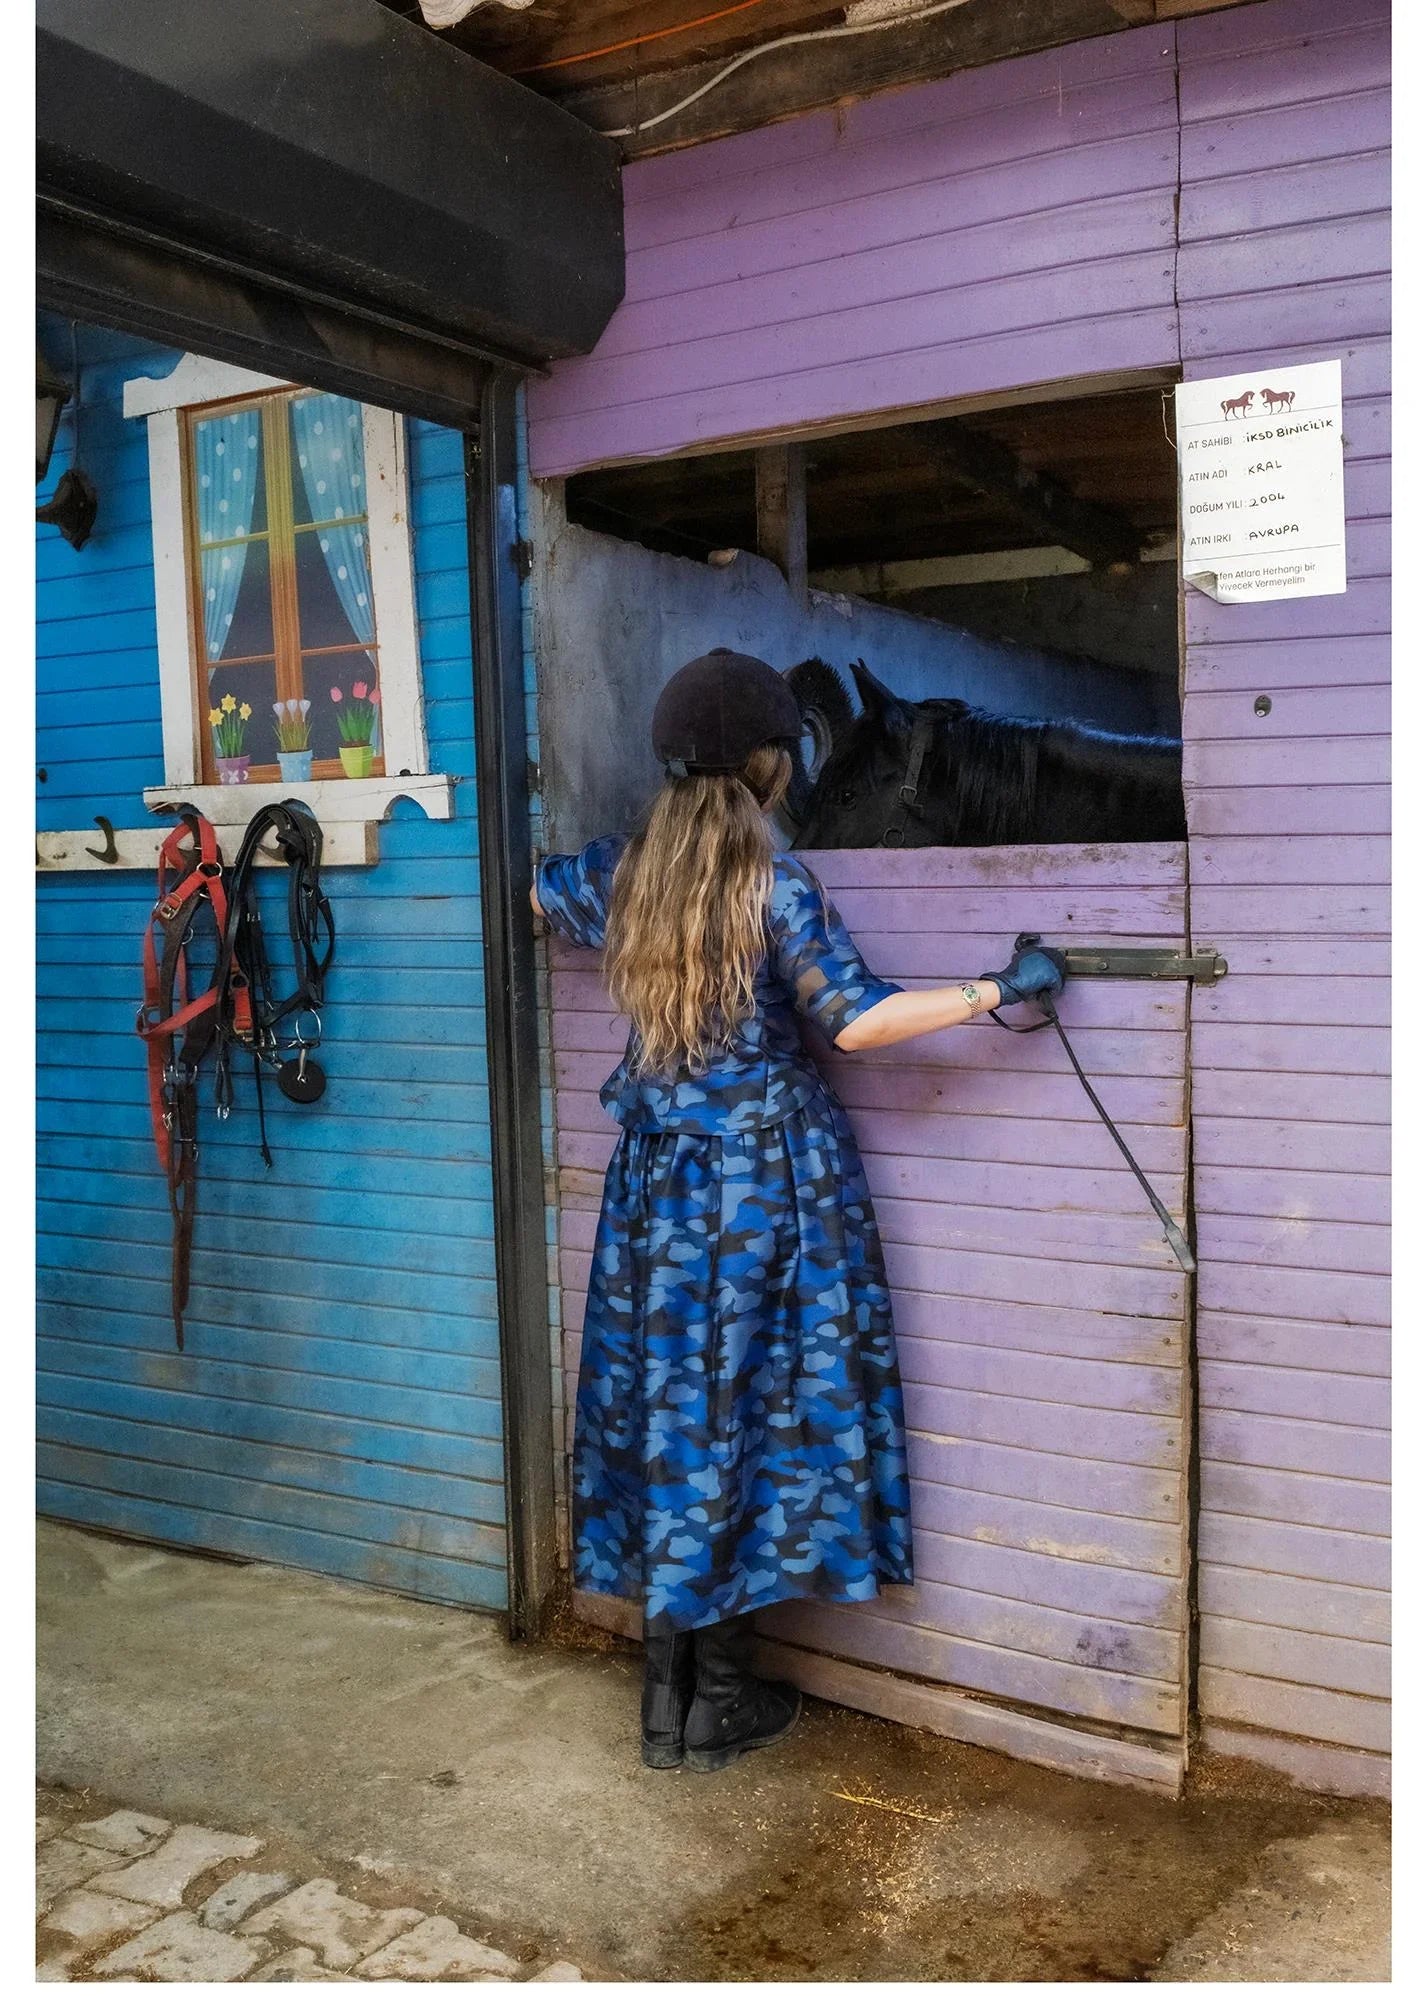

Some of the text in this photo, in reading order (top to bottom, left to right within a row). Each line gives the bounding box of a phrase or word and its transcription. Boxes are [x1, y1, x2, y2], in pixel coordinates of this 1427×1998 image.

[1187, 440, 1199, 450] AT
[1248, 460, 1283, 475] KRAL
[1188, 469, 1228, 482] ATIN ADI
[1249, 492, 1286, 508] 2004
[1189, 502, 1224, 514] DOĞUM
[1249, 524, 1300, 541] AVRUPA
[1190, 535, 1211, 546] ATIN
[1263, 565, 1303, 577] Herhangi
[1304, 563, 1316, 571] bir
